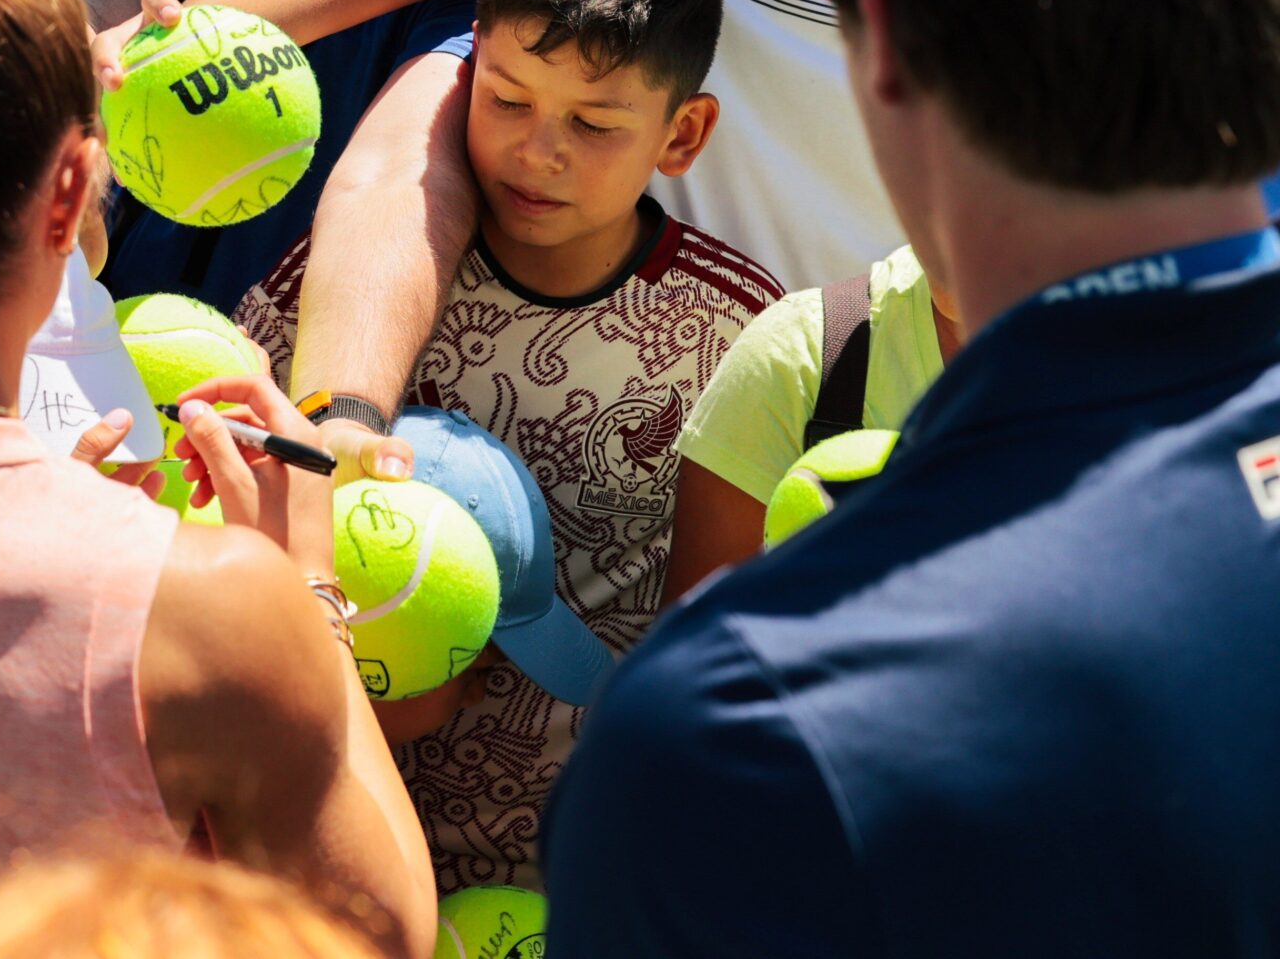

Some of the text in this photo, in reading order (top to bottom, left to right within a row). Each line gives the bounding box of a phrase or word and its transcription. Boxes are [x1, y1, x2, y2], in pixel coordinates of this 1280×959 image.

[169, 45, 306, 115] Wilson
[265, 87, 283, 118] 1
[584, 488, 662, 512] MÉXICO
